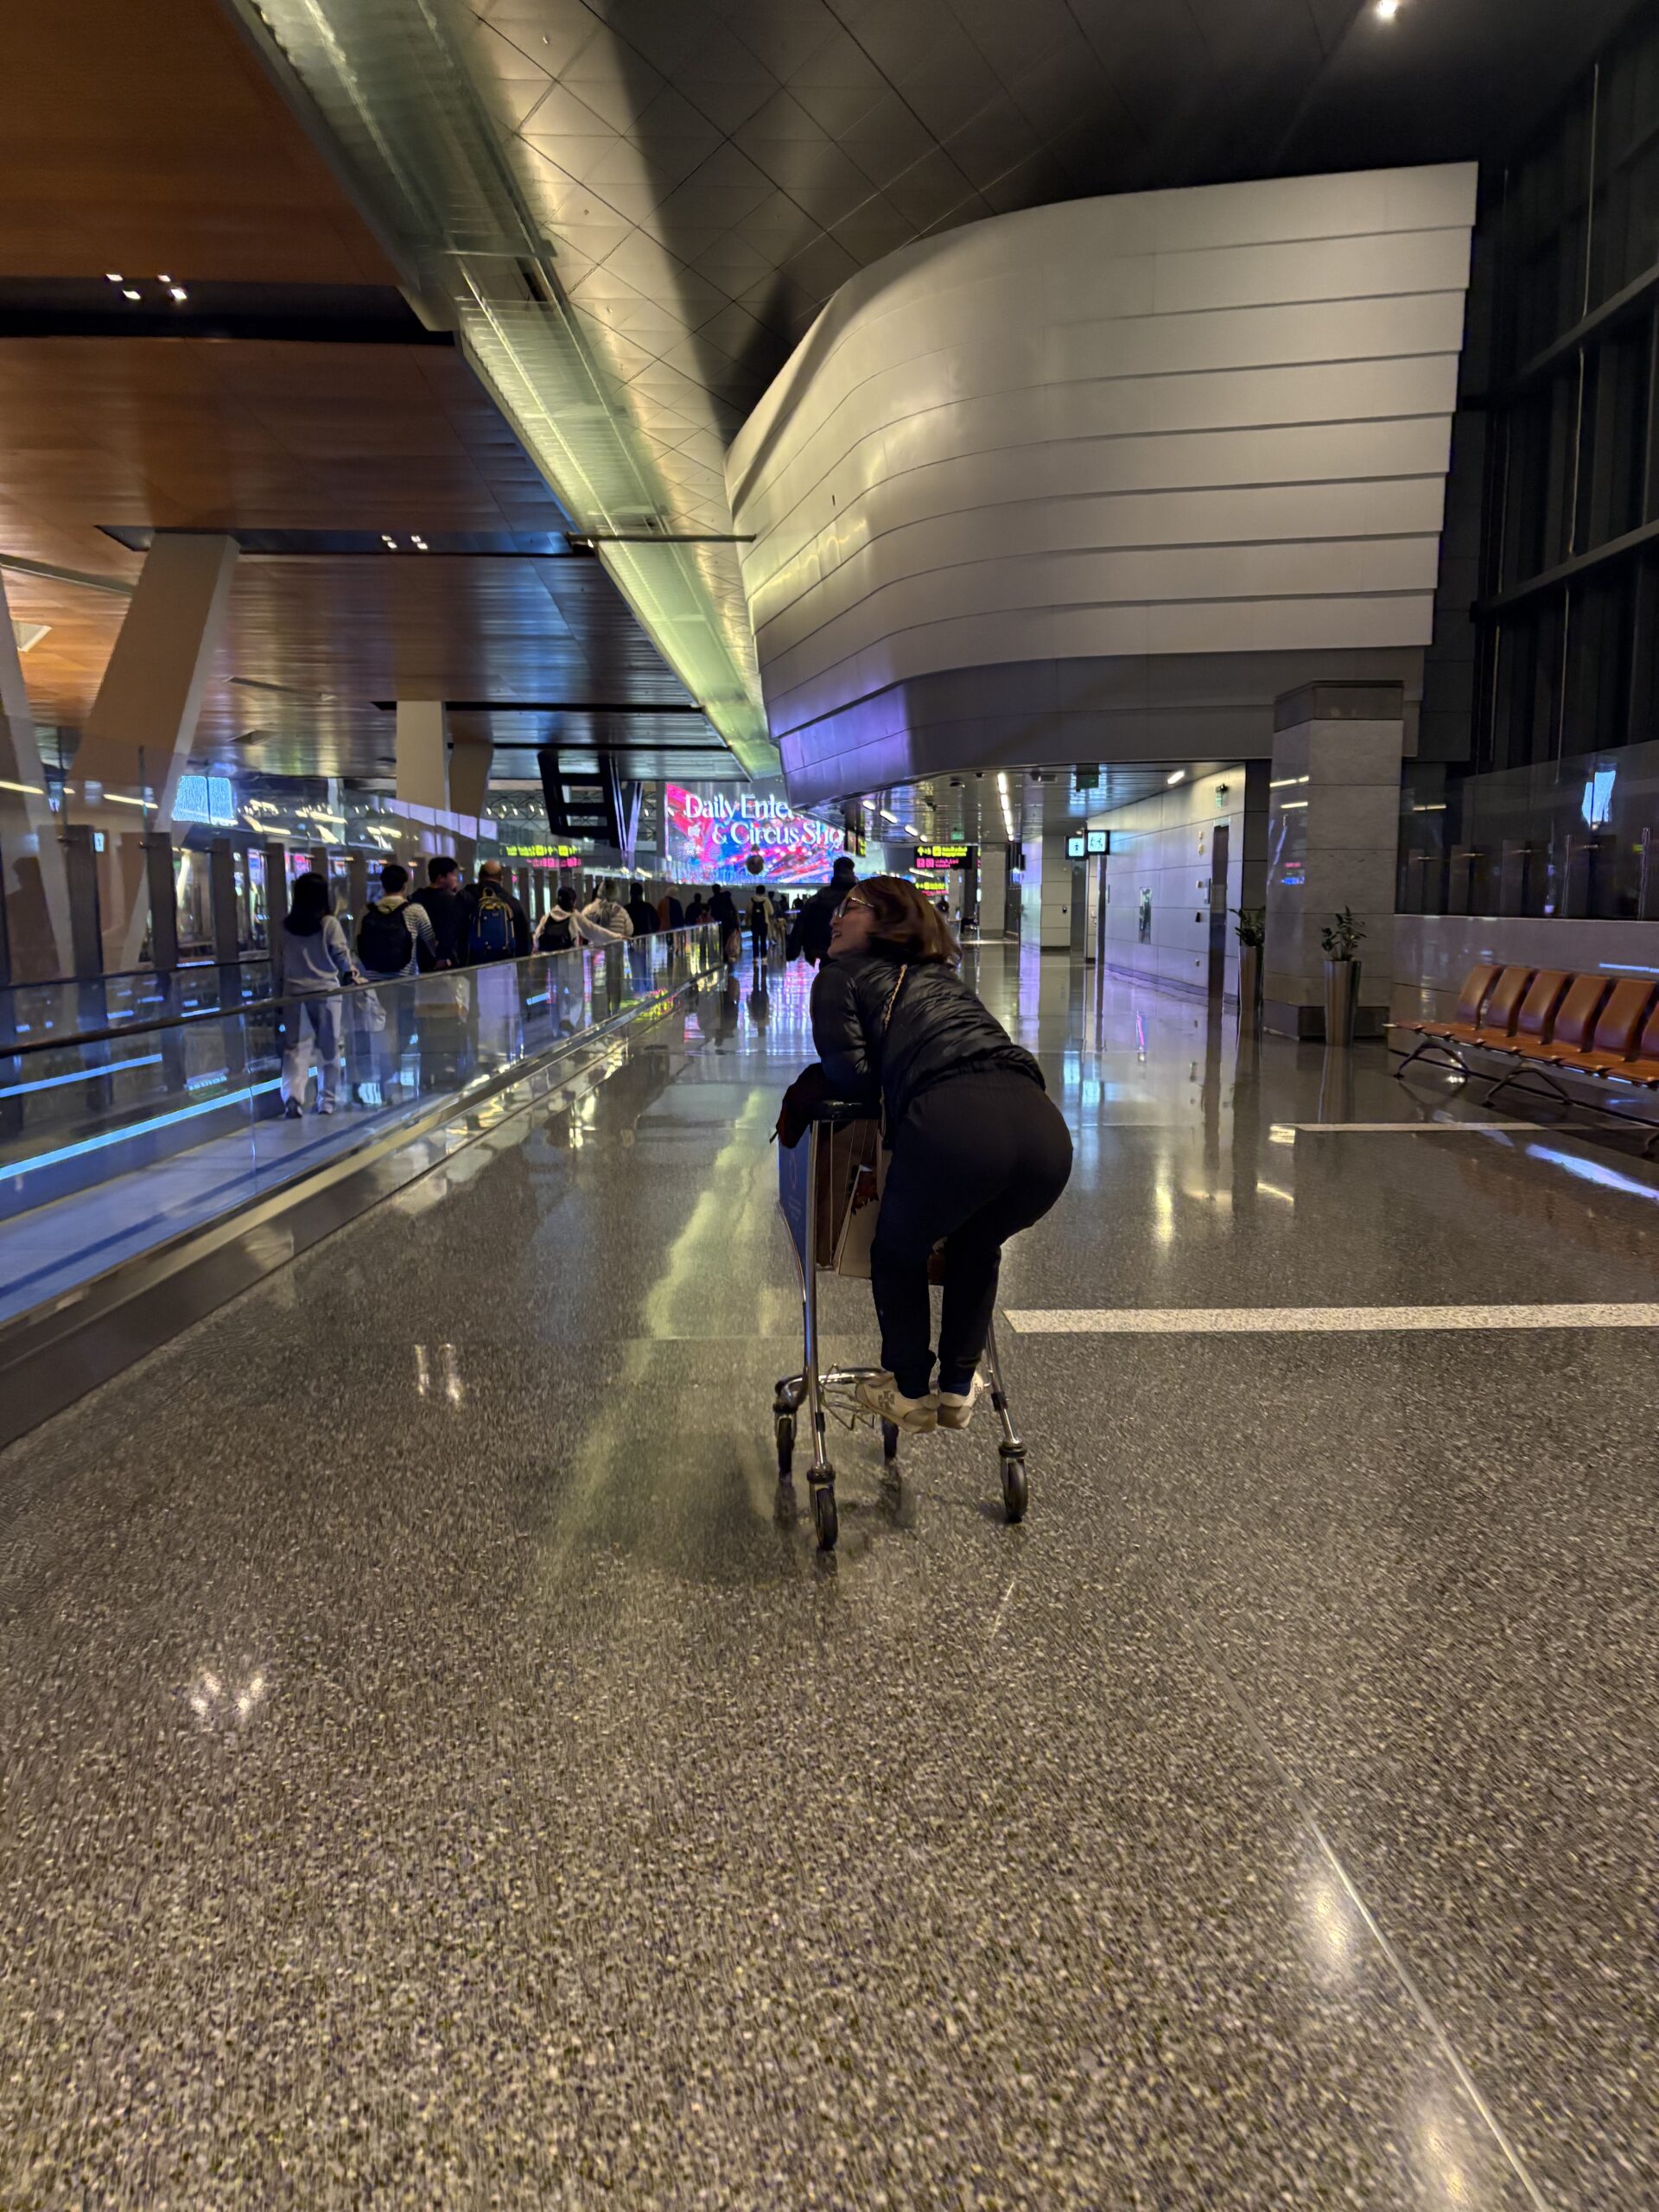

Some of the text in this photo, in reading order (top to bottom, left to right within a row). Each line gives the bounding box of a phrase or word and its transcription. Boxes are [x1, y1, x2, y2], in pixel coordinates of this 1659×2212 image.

[684, 793, 736, 825] Daily
[712, 821, 844, 845] & Circus Sho
